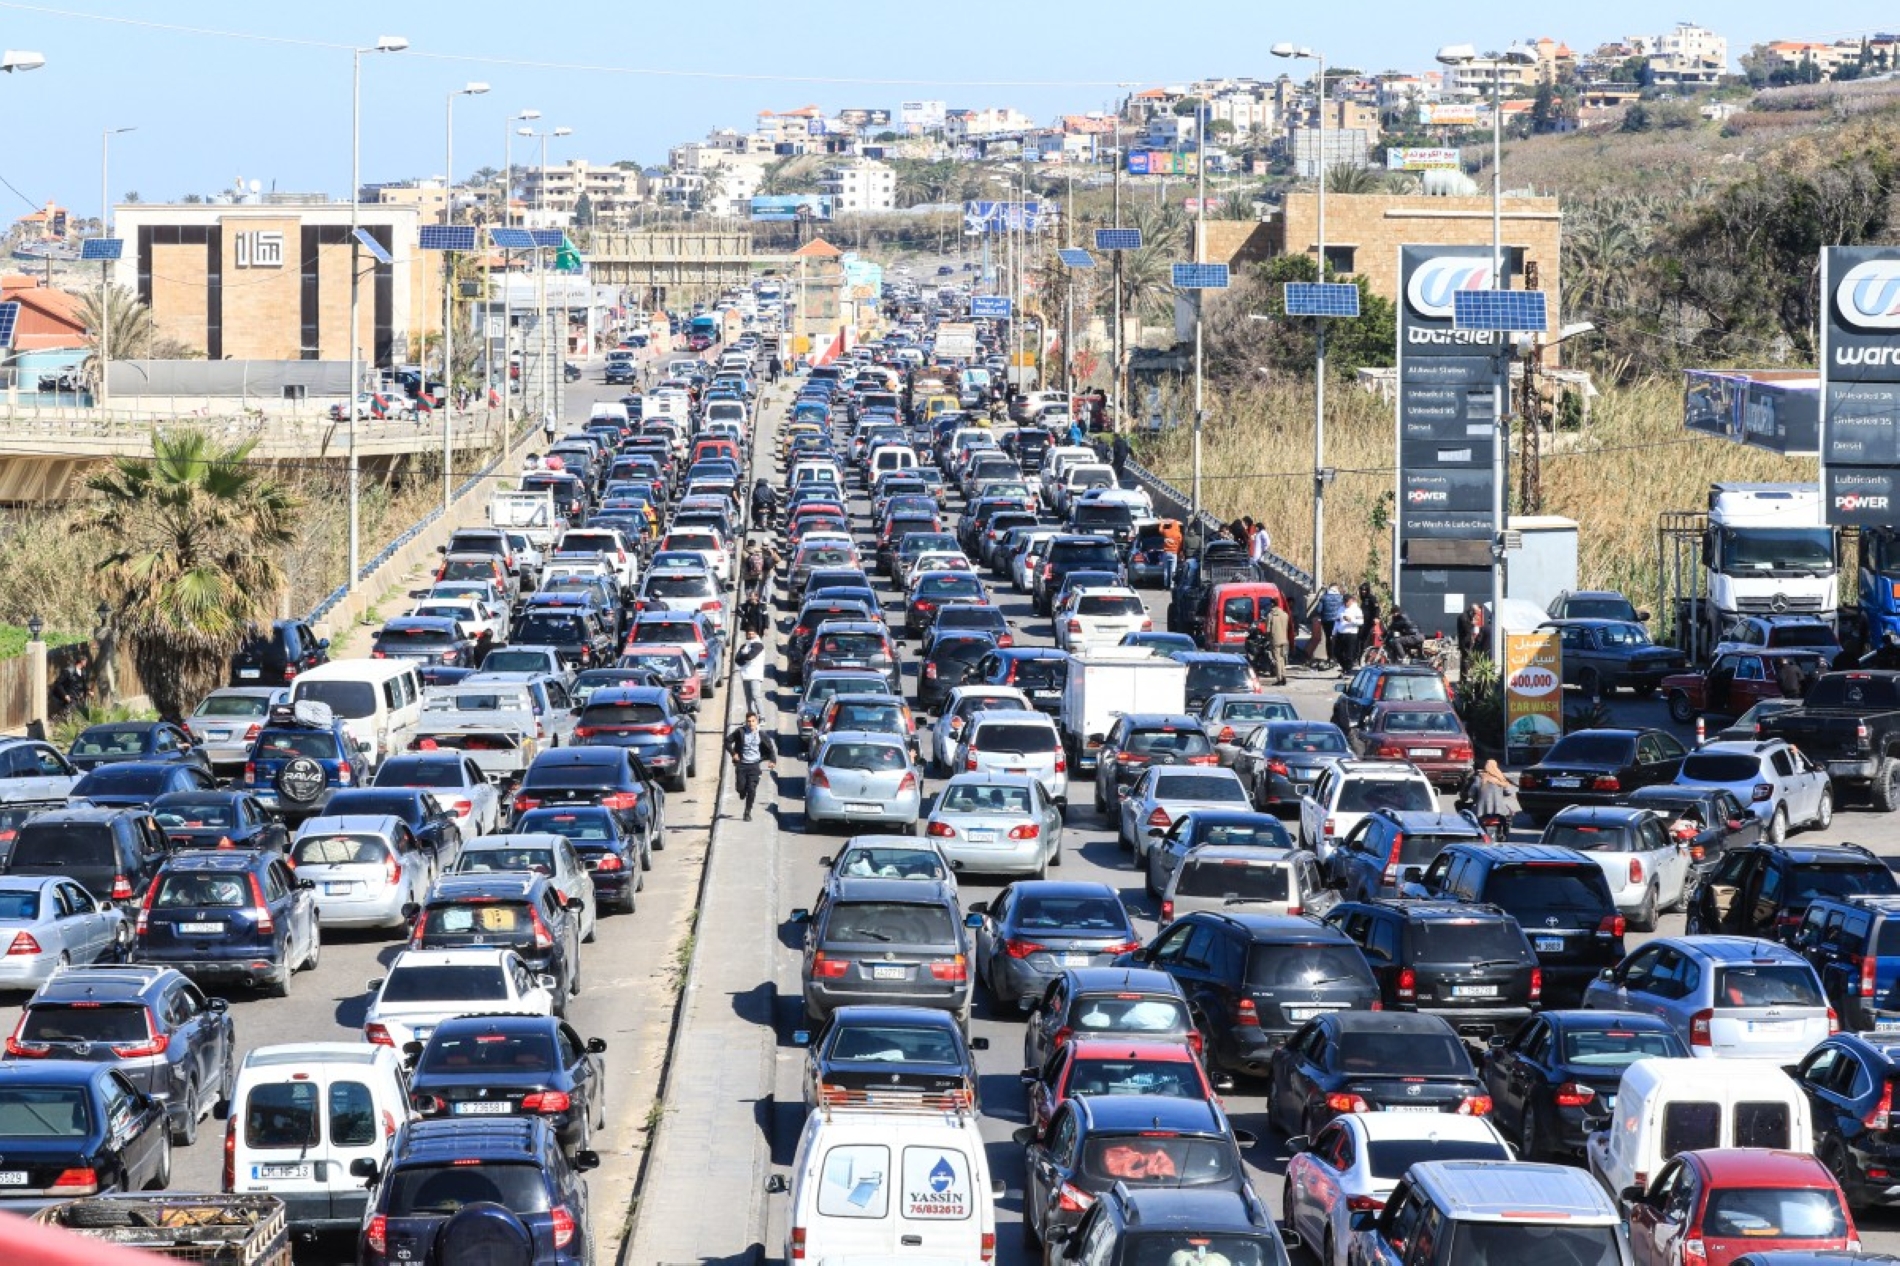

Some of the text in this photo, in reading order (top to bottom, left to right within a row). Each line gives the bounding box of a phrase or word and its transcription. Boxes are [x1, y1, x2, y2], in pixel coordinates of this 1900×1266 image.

[1407, 390, 1444, 399] Unleaded
[1834, 390, 1879, 400] Unleaded
[1407, 406, 1444, 414] Unleaded
[1833, 416, 1892, 425] Unleaded 95
[1407, 423, 1431, 431] Diesel
[1833, 441, 1862, 451] Diesel
[1834, 475, 1890, 484] Lubricants
[1407, 490, 1447, 500] POWER
[1834, 496, 1889, 508] POWER
[1407, 520, 1421, 528] Car
[1421, 520, 1444, 528] Wash
[1452, 520, 1471, 528] Lube
[1514, 637, 1551, 650] غسيل
[1511, 654, 1556, 666] سيارات
[1510, 674, 1552, 689] 400,000
[1510, 700, 1559, 712] CAR WASH
[283, 772, 323, 783] RAV4
[909, 1204, 964, 1215] 76/832612
